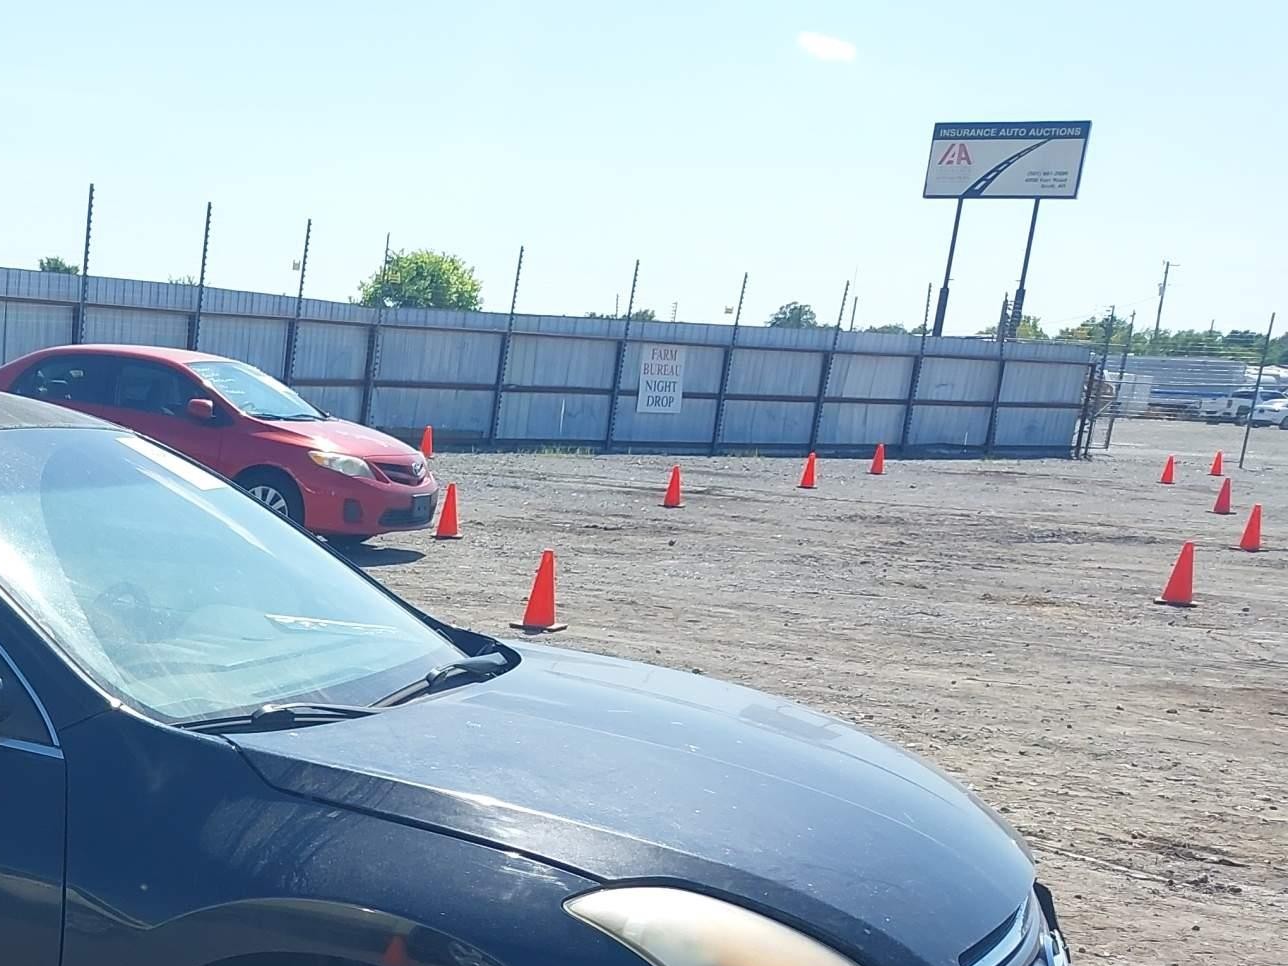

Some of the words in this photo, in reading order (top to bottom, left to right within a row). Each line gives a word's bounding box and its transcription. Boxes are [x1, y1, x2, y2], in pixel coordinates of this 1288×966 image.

[940, 128, 997, 137] INSURANCE
[999, 128, 1027, 137] AUTO
[1028, 127, 1082, 137] AUCTIONS
[651, 348, 678, 362] FARM
[643, 362, 682, 377] BUREAU
[645, 380, 678, 393] NIGHT
[646, 395, 675, 408] DROP
